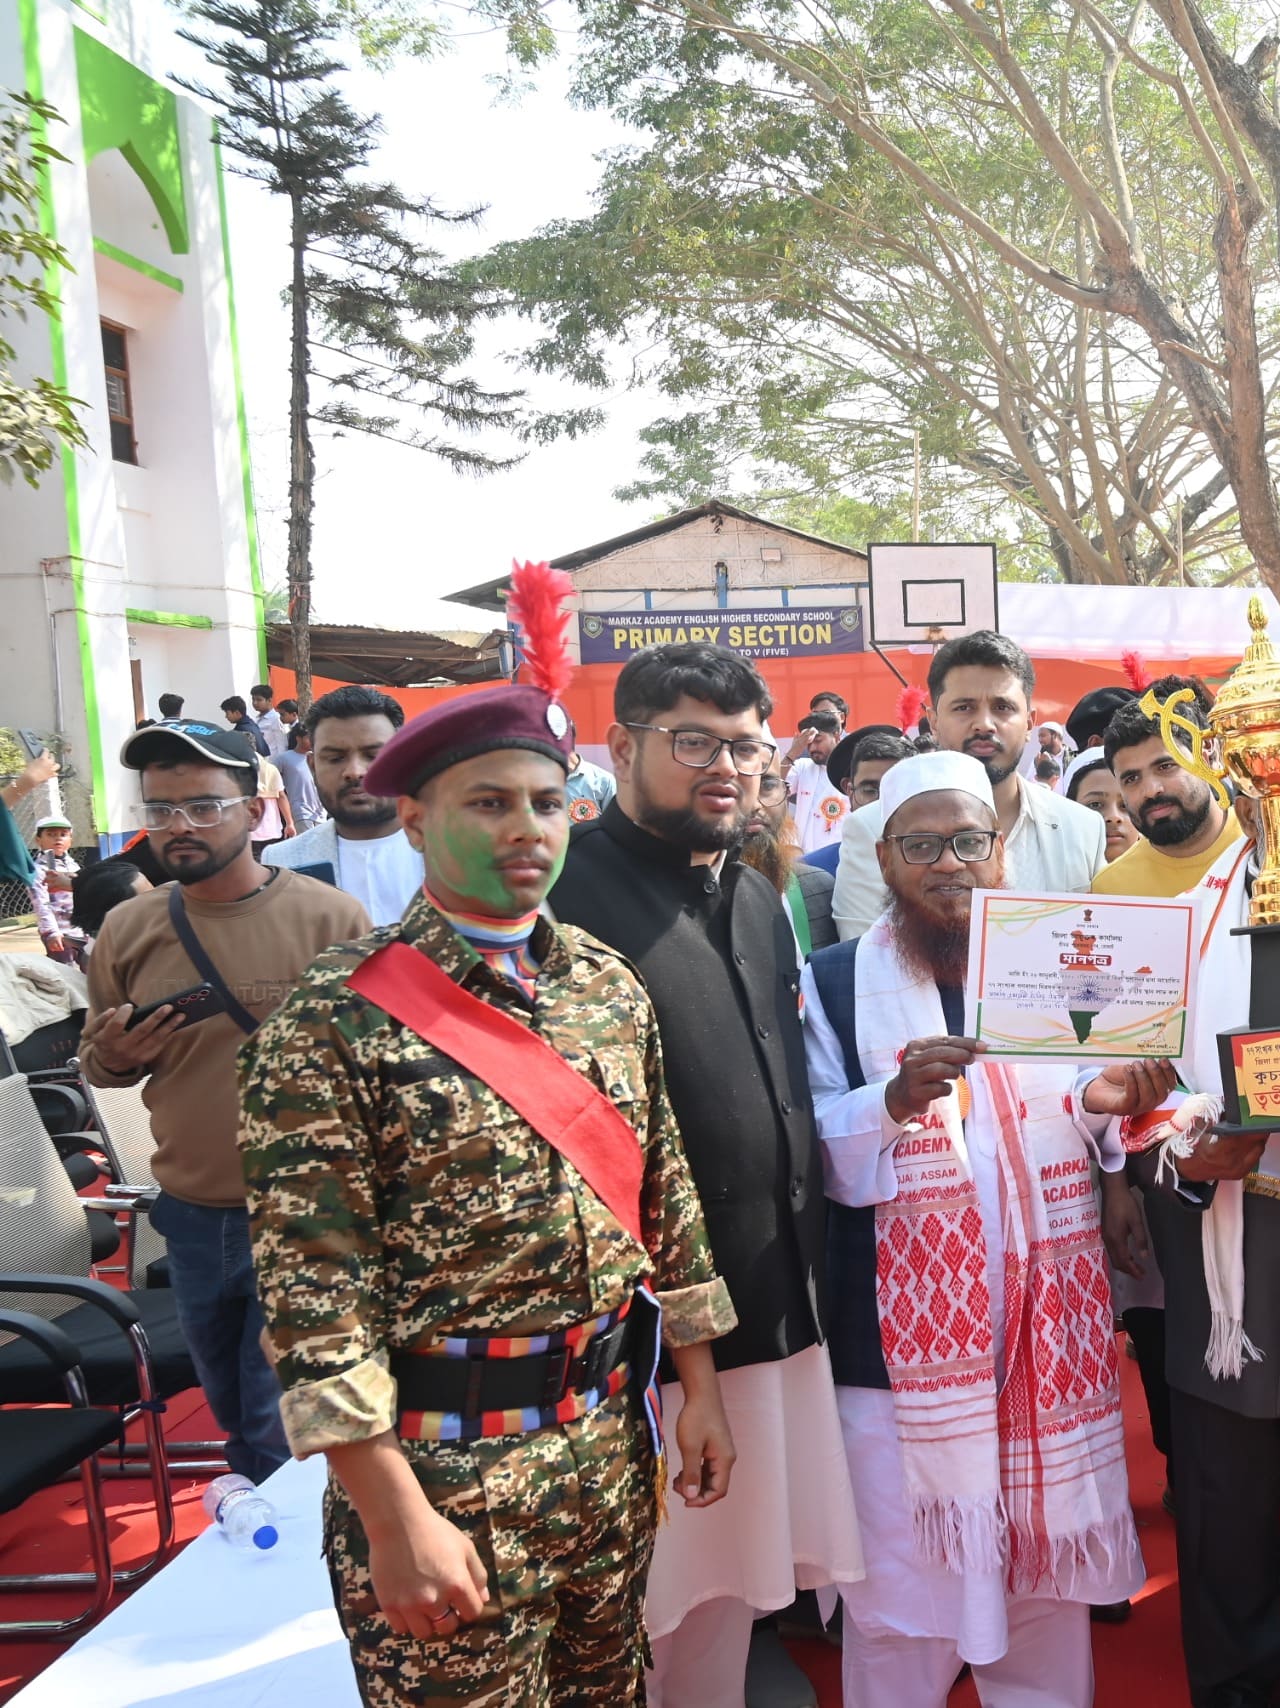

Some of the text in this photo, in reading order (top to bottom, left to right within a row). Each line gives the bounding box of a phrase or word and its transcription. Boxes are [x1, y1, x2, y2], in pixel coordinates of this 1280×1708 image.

[608, 611, 835, 626] MARKAZ ACADEMY ENGLISH HIGHER SECONDARY SCHOOL
[613, 623, 832, 650] PRIMARY SECTION
[739, 648, 751, 656] TO
[753, 648, 760, 656] V
[762, 648, 789, 657] (FIVE)
[920, 1167, 957, 1181] ASSAM
